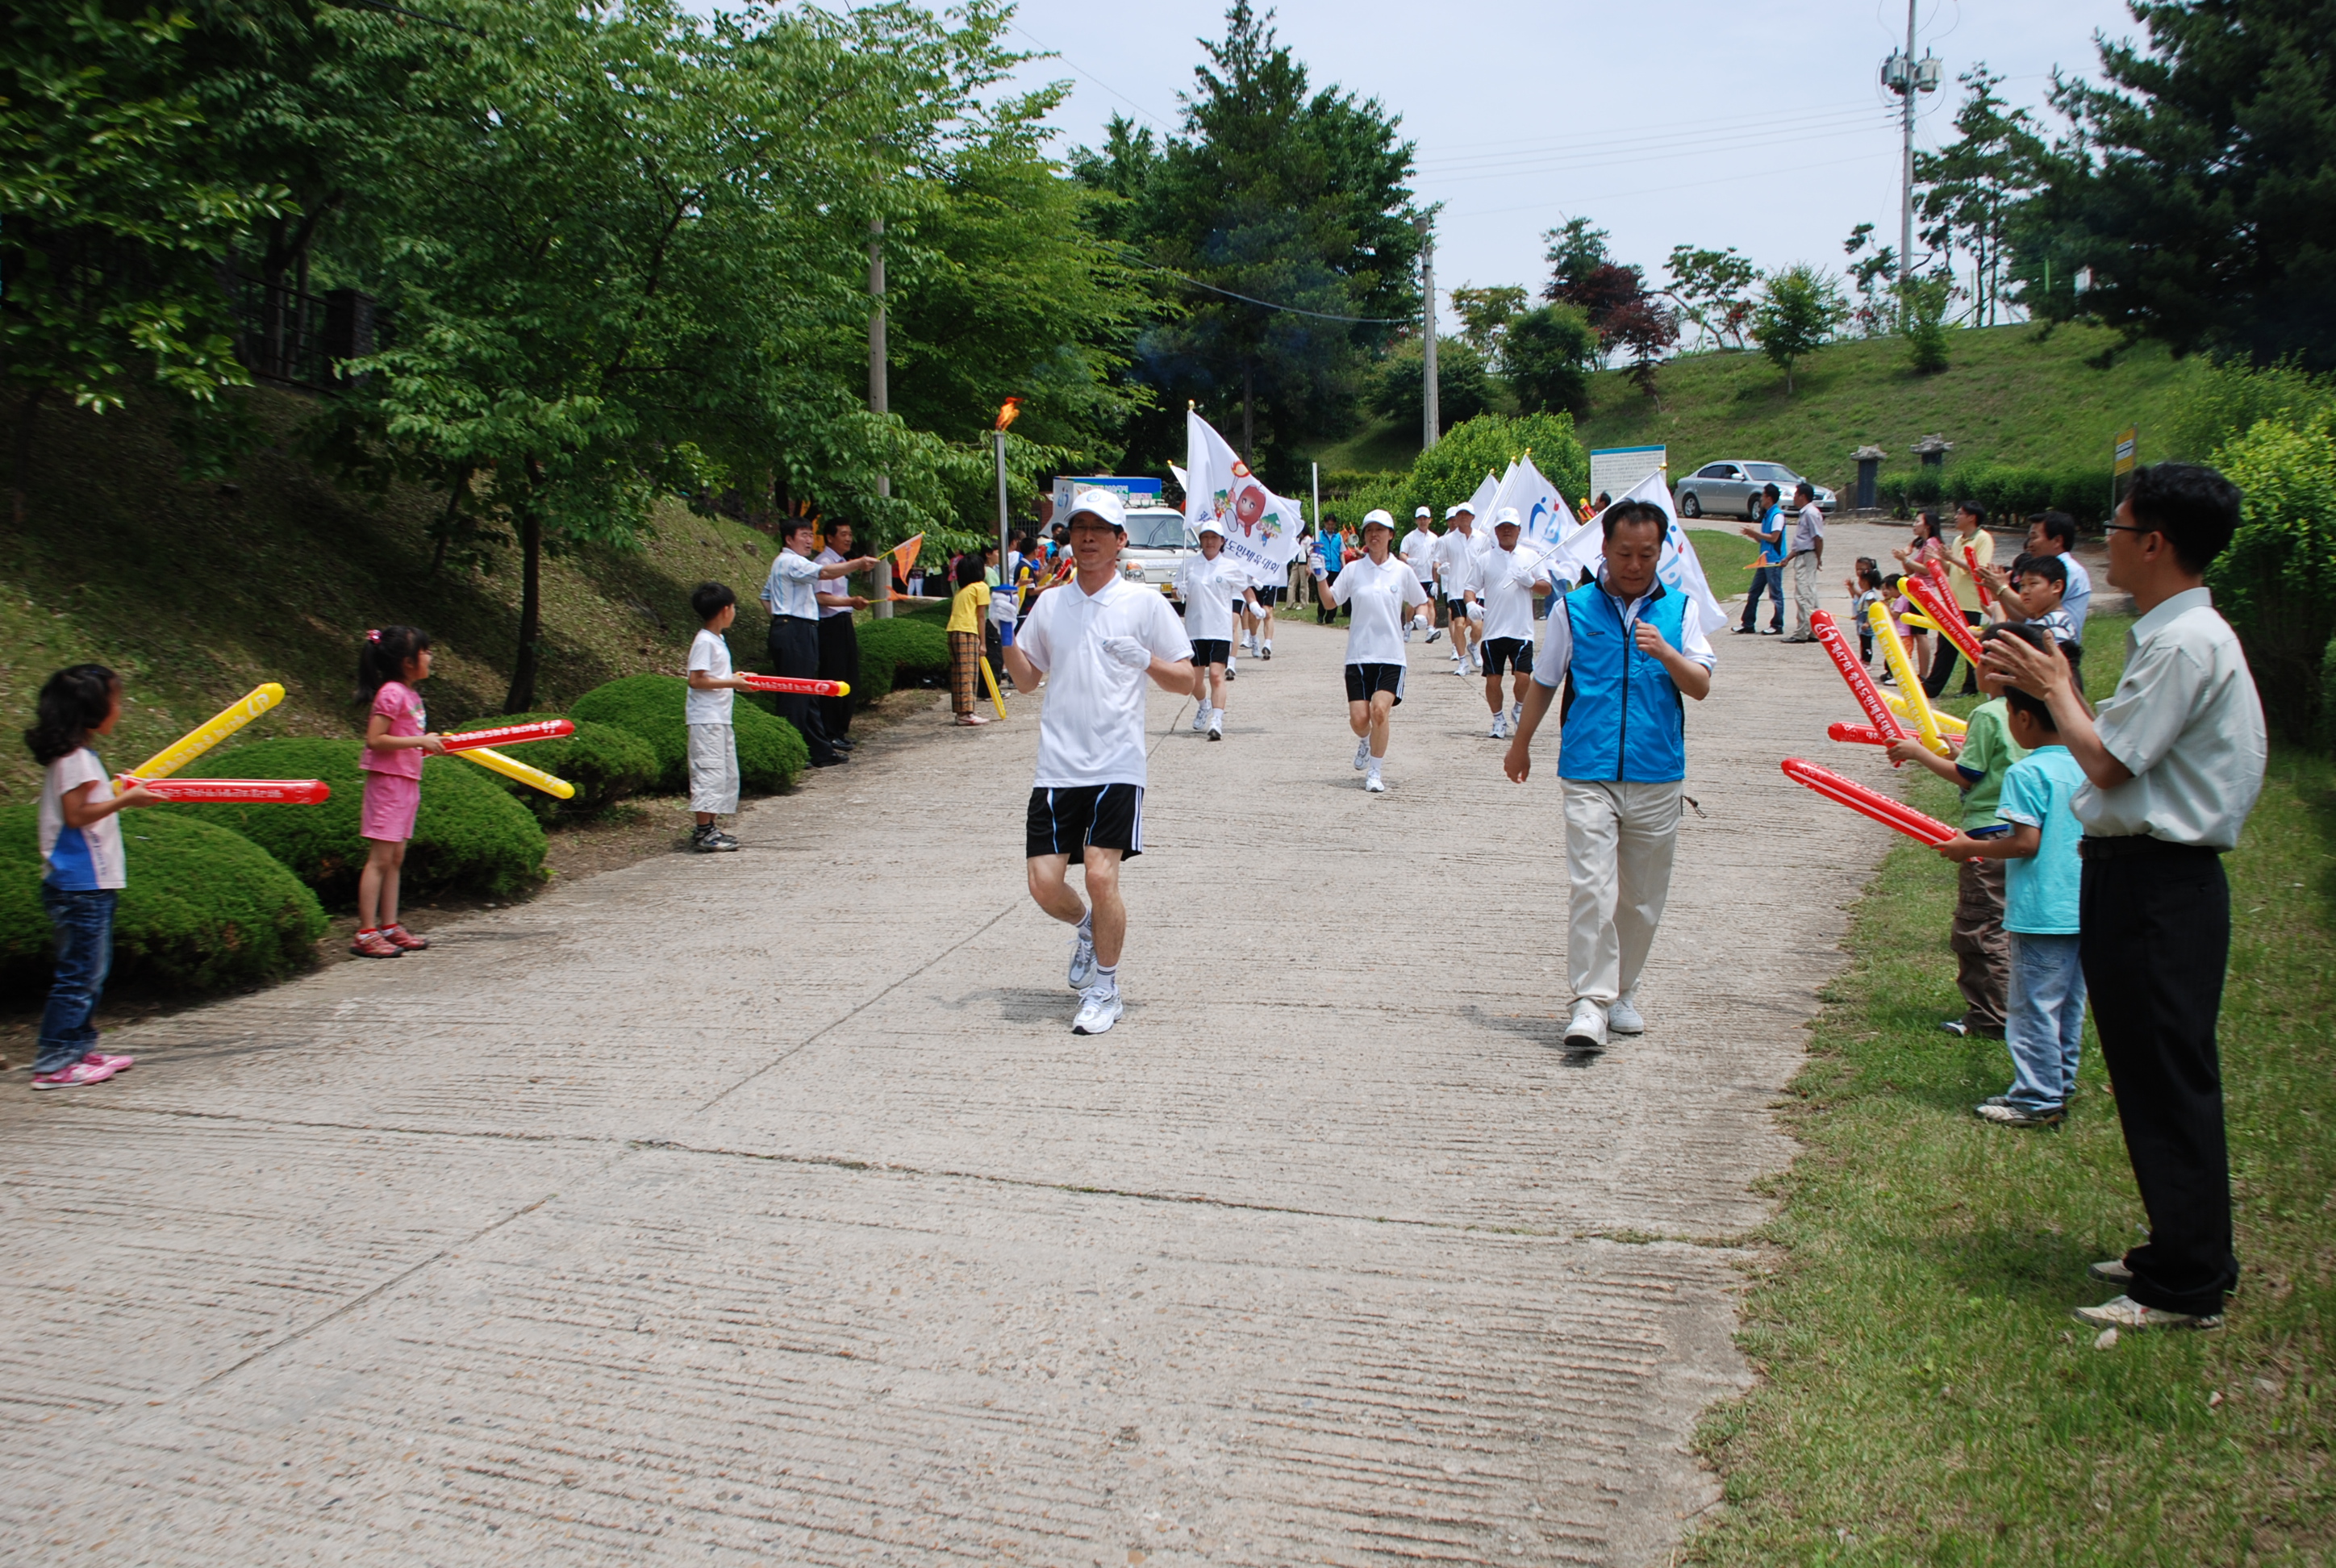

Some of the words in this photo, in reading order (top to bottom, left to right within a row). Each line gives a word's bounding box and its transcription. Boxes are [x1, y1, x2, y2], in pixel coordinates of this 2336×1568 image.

[1224, 538, 1280, 574] 도민체육대회
[1831, 641, 1854, 672] 제47회
[1848, 671, 1898, 739] 충북도민체육대회
